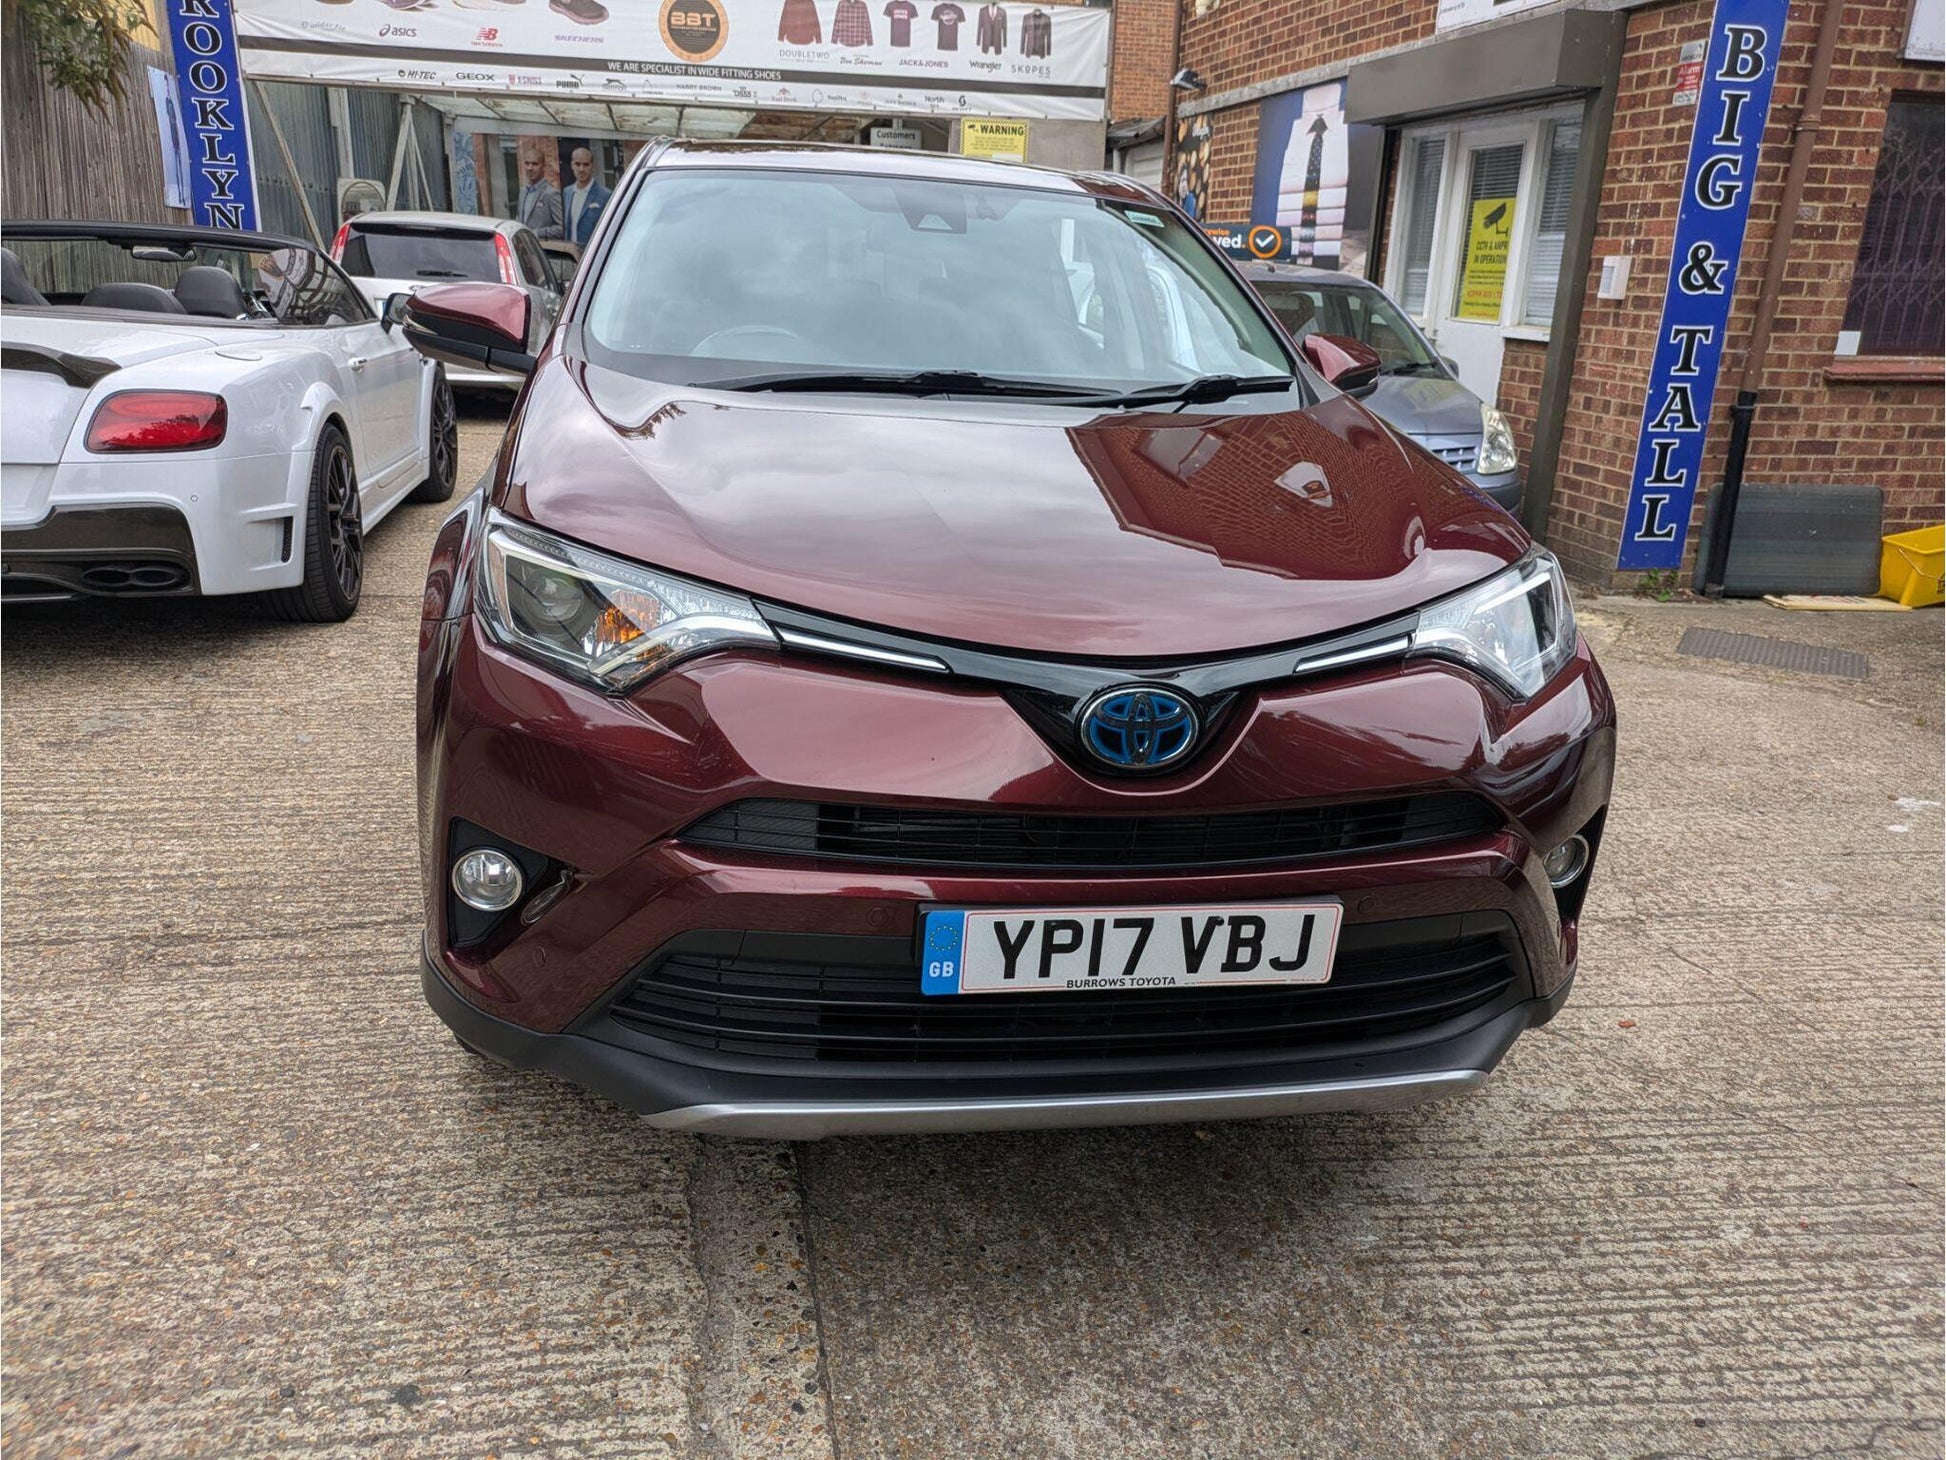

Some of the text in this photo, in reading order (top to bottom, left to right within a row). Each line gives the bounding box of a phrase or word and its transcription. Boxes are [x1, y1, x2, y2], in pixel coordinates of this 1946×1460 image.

[671, 11, 716, 27] BBT
[391, 26, 418, 37] asics
[554, 34, 604, 44] SKECHERS
[608, 61, 782, 81] WE ARE SPECIALIST IN WIDE FITTING SHOES
[969, 60, 1002, 73] Wrangler
[407, 70, 437, 80] HI-TEC
[456, 72, 496, 81] GEOX
[877, 130, 916, 140] Customers
[980, 125, 1025, 136] WARNING
[1634, 24, 1767, 541] BIG & TALL
[993, 914, 1316, 979] YP17 VBJ
[929, 962, 954, 978] GB
[1066, 976, 1177, 989] BURROWS TOYOTA
